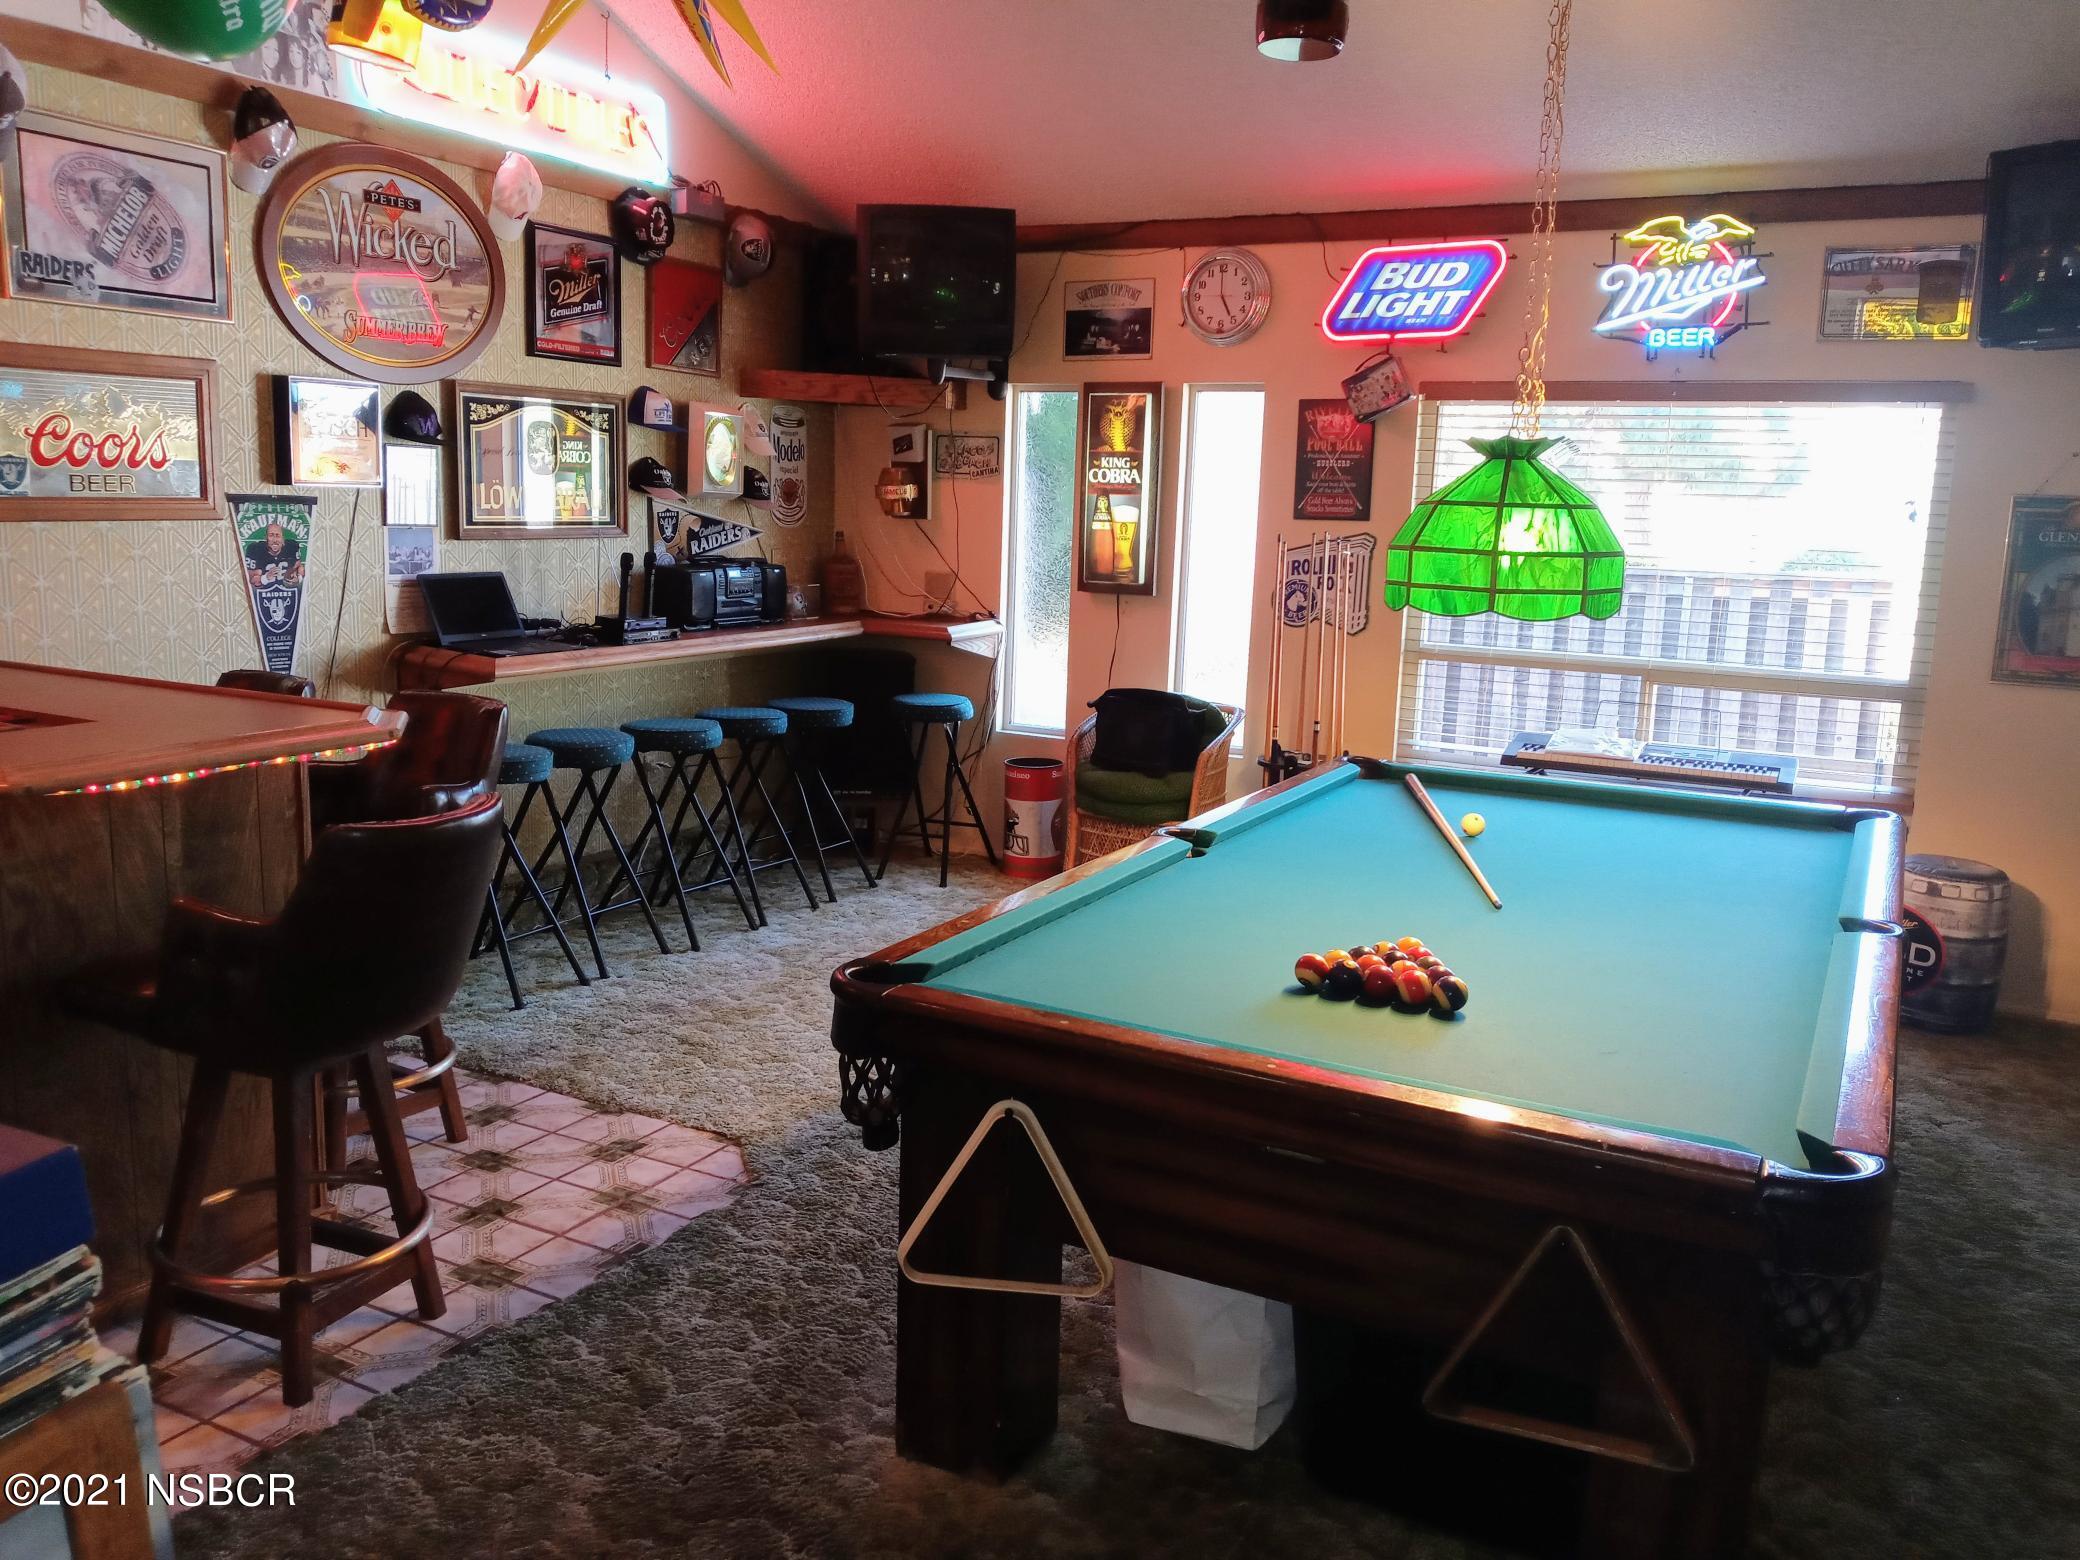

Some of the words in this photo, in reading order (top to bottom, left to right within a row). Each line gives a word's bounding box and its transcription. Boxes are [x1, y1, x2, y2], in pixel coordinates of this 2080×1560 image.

[370, 192, 416, 210] PETE'S
[101, 186, 150, 258] MICHELOB
[316, 181, 460, 283] Wicked
[131, 213, 159, 260] Golden
[143, 226, 168, 263] Draft
[20, 251, 95, 280] RAIDERS
[1370, 262, 1469, 290] BUD
[549, 272, 601, 304] Miller
[1600, 259, 1757, 318] Miller
[550, 305, 582, 318] Genuine
[582, 300, 602, 312] Draft
[1338, 290, 1472, 319] LIGHT
[343, 310, 403, 343] SUMMER
[403, 318, 448, 348] BREW
[1649, 327, 1715, 347] BEER
[24, 413, 171, 469] Coors
[971, 467, 999, 478] CANTINA
[1089, 468, 1141, 484] COBRA
[1100, 457, 1130, 468] KING
[69, 474, 136, 493] BEER
[240, 514, 308, 539] KAUFMAN
[691, 527, 742, 555] RAIDERS
